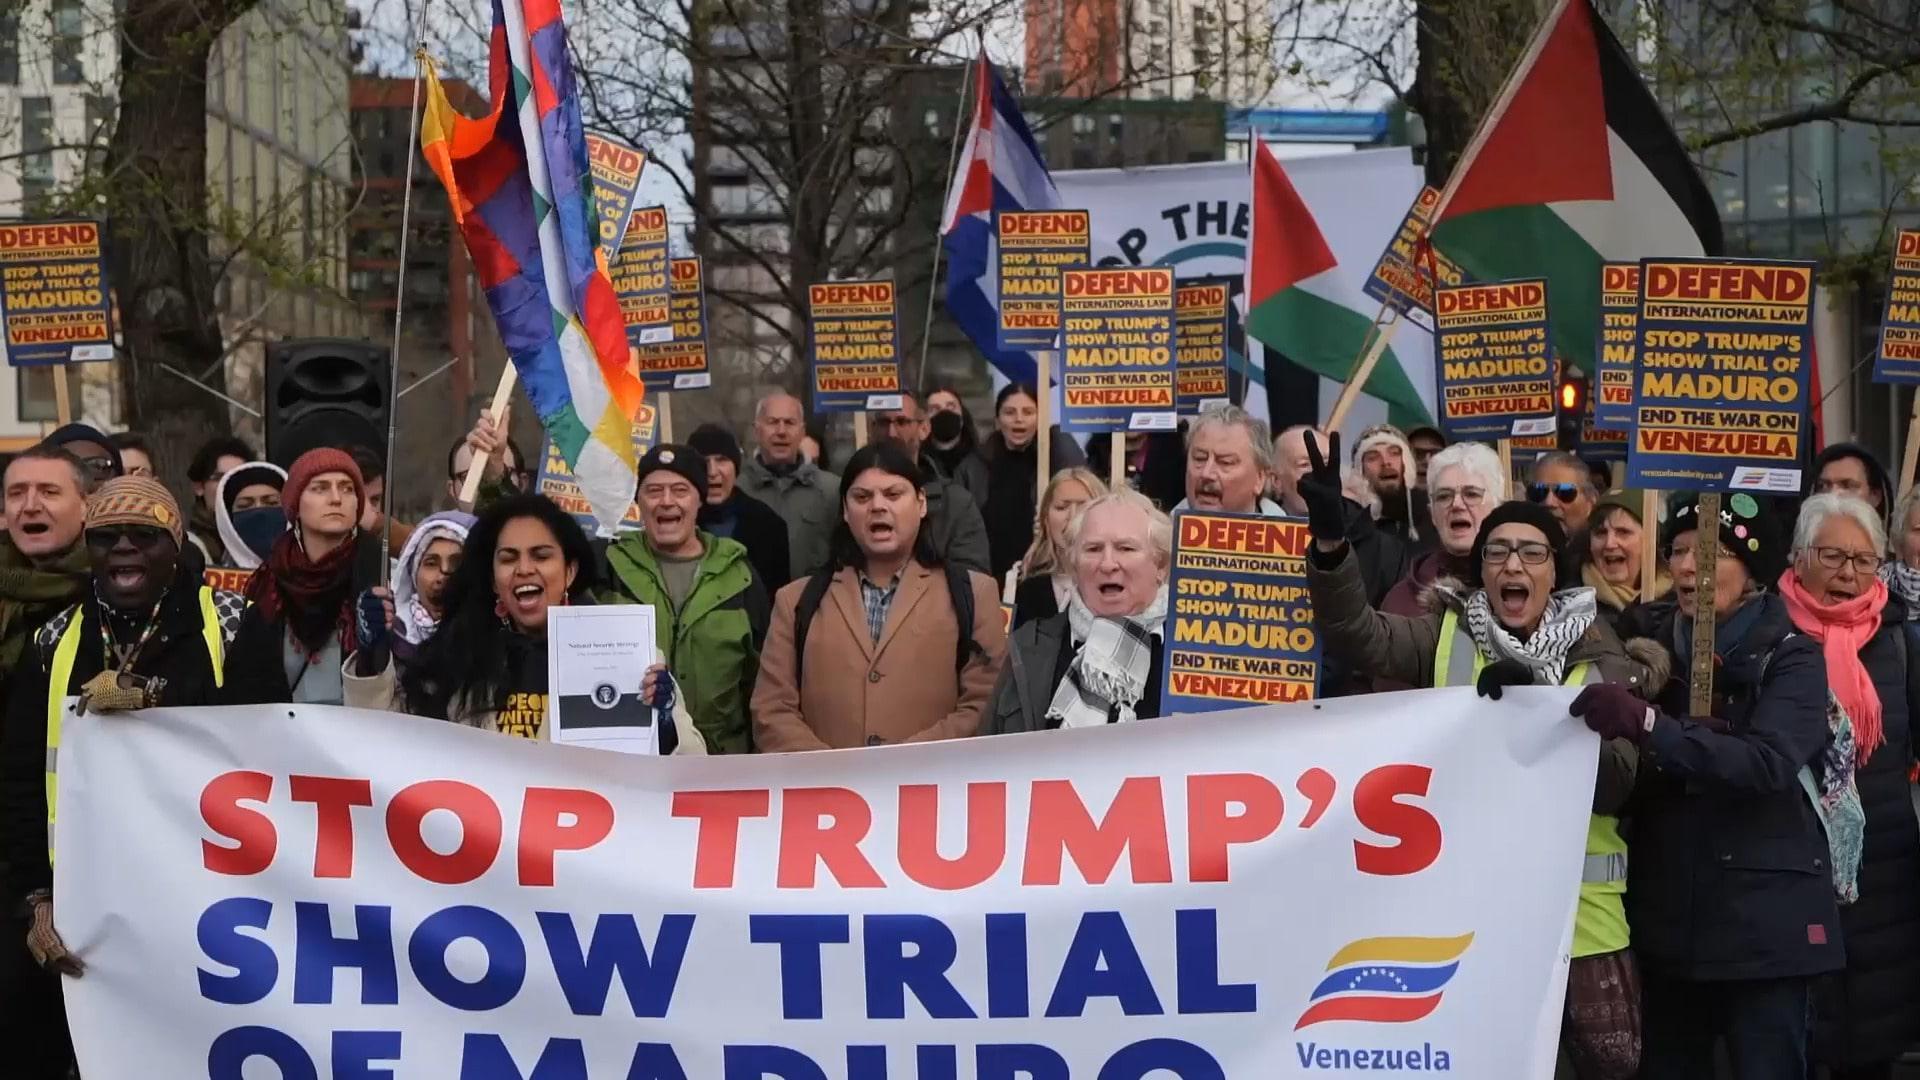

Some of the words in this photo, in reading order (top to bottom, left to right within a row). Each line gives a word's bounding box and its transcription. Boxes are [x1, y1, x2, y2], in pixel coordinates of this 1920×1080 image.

[587, 138, 638, 173] END
[594, 185, 626, 208] MP'S
[1001, 214, 1086, 234] DEFEND
[1161, 200, 1249, 242] THE
[0, 226, 96, 246] DEFEND
[1002, 254, 1032, 264] STOP
[4, 268, 37, 277] STOP
[41, 265, 98, 276] TRUMP'S
[6, 281, 44, 290] SHOW
[48, 279, 81, 288] TRIAL
[85, 278, 100, 286] OF
[613, 273, 666, 292] ADURO
[1002, 279, 1060, 294] MADU
[1065, 272, 1169, 295] DEFEND
[1648, 267, 1807, 301] DEFEND
[1893, 276, 1920, 288] STO
[7, 290, 101, 309] MADURO
[811, 285, 891, 303] DEFEND
[1176, 288, 1223, 308] EFEND
[1438, 285, 1542, 313] DEFEND
[1066, 300, 1145, 309] INTERNATIONAL
[1647, 306, 1767, 320] INTERNATIONAL
[1770, 310, 1803, 320] LAW
[623, 309, 667, 325] EZUELA
[814, 323, 840, 331] STOP
[844, 321, 892, 330] TRUMP'S
[1003, 314, 1060, 327] VENEZU
[1065, 319, 1101, 330] STOP
[1105, 317, 1169, 329] TRUMP'S
[1440, 313, 1519, 326] INTERNATIONAL
[12, 326, 104, 342] VENEZUELA
[1066, 334, 1107, 345] SHOW
[1111, 333, 1148, 344] TRIAL
[1152, 333, 1169, 343] OF
[1441, 334, 1477, 346] STOP
[1480, 328, 1544, 343] TRUMP'S
[1604, 329, 1636, 341] SHO
[1644, 331, 1699, 348] STOP
[1704, 333, 1801, 352] TRUMP'S
[1886, 330, 1906, 340] END
[816, 345, 894, 360] MADURO
[1066, 347, 1169, 366] MADURO
[1177, 347, 1222, 363] ADURO
[1442, 348, 1484, 360] SHOW
[1487, 345, 1525, 356] TRIAL
[1528, 343, 1546, 354] OF
[641, 356, 703, 370] NEZUELA
[1444, 356, 1547, 380] MADURO
[1643, 353, 1706, 369] SHOW
[1712, 355, 1768, 371] TRIAL
[1773, 357, 1800, 372] OF
[819, 378, 896, 389] VENEZUELA
[1066, 376, 1090, 384] END
[1093, 375, 1115, 384] THE
[1119, 375, 1146, 383] WAR
[1151, 374, 1170, 383] ON
[1602, 372, 1627, 382] END
[1446, 388, 1470, 397] END
[1472, 386, 1495, 395] THE
[1498, 384, 1525, 393] WAR
[1529, 382, 1548, 391] ON
[1642, 372, 1798, 403] MADURO
[1068, 390, 1170, 404] VENEZUELA
[1448, 396, 1549, 416] VENEZUELA
[1641, 410, 1676, 423] END
[1680, 412, 1714, 425] THE
[1719, 413, 1761, 427] WAR
[1766, 415, 1796, 428] ON
[1641, 431, 1794, 456] VENEZUELA
[544, 481, 566, 492] END
[1180, 554, 1287, 572] INTERNATIONAL
[1291, 563, 1306, 574] LA
[1177, 578, 1227, 596] STOP
[1176, 598, 1233, 616] SHOW
[1238, 603, 1289, 621] TRIAL
[1175, 617, 1316, 652] MADURO
[1173, 653, 1206, 667] END
[1209, 656, 1240, 670] THE
[1244, 659, 1282, 674] WAR
[1287, 662, 1314, 676] ON
[1173, 674, 1312, 702] VENEZUELA
[199, 770, 615, 887] STOP
[671, 763, 1442, 891] TRUMP'S
[196, 896, 697, 1019] SHOW
[749, 908, 1257, 1020] TRIAL
[1295, 1041, 1451, 1072] Venezuela
